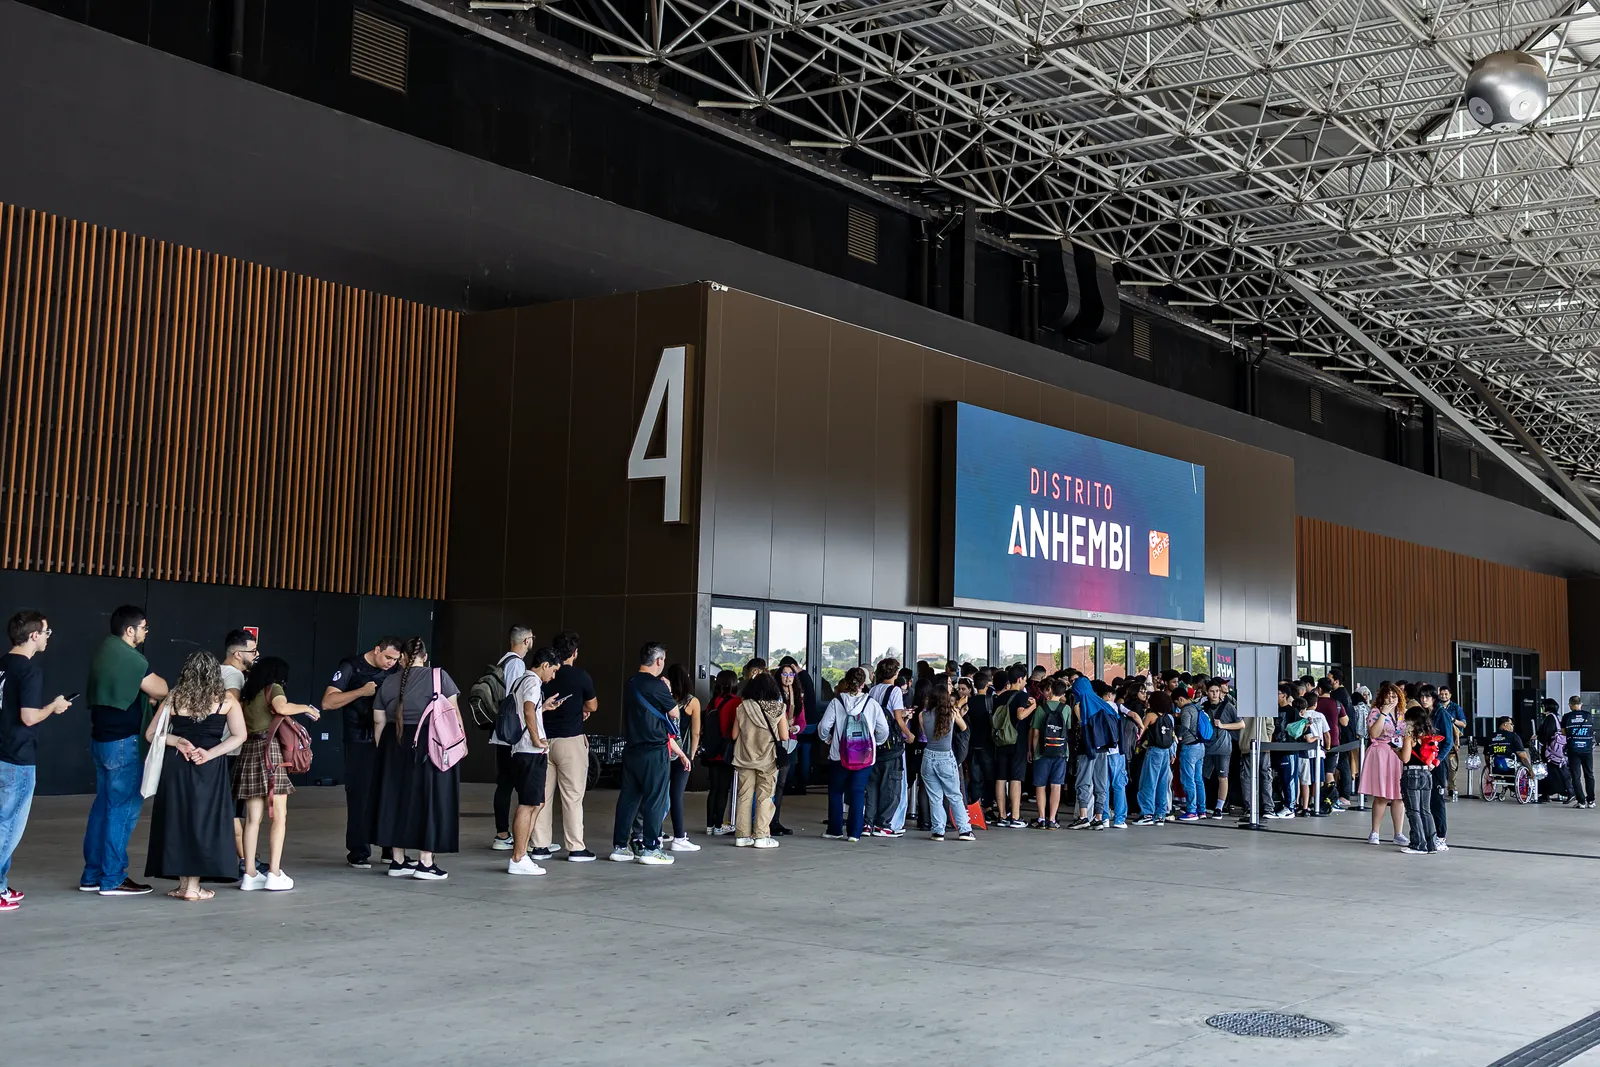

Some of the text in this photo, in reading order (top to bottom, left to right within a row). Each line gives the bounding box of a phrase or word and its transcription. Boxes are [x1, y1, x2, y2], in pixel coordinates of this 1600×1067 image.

[627, 346, 686, 523] 4
[1030, 467, 1113, 510] DISTRITO
[1007, 504, 1131, 572] ANHEMBI
[1482, 657, 1508, 668] SPOLETO
